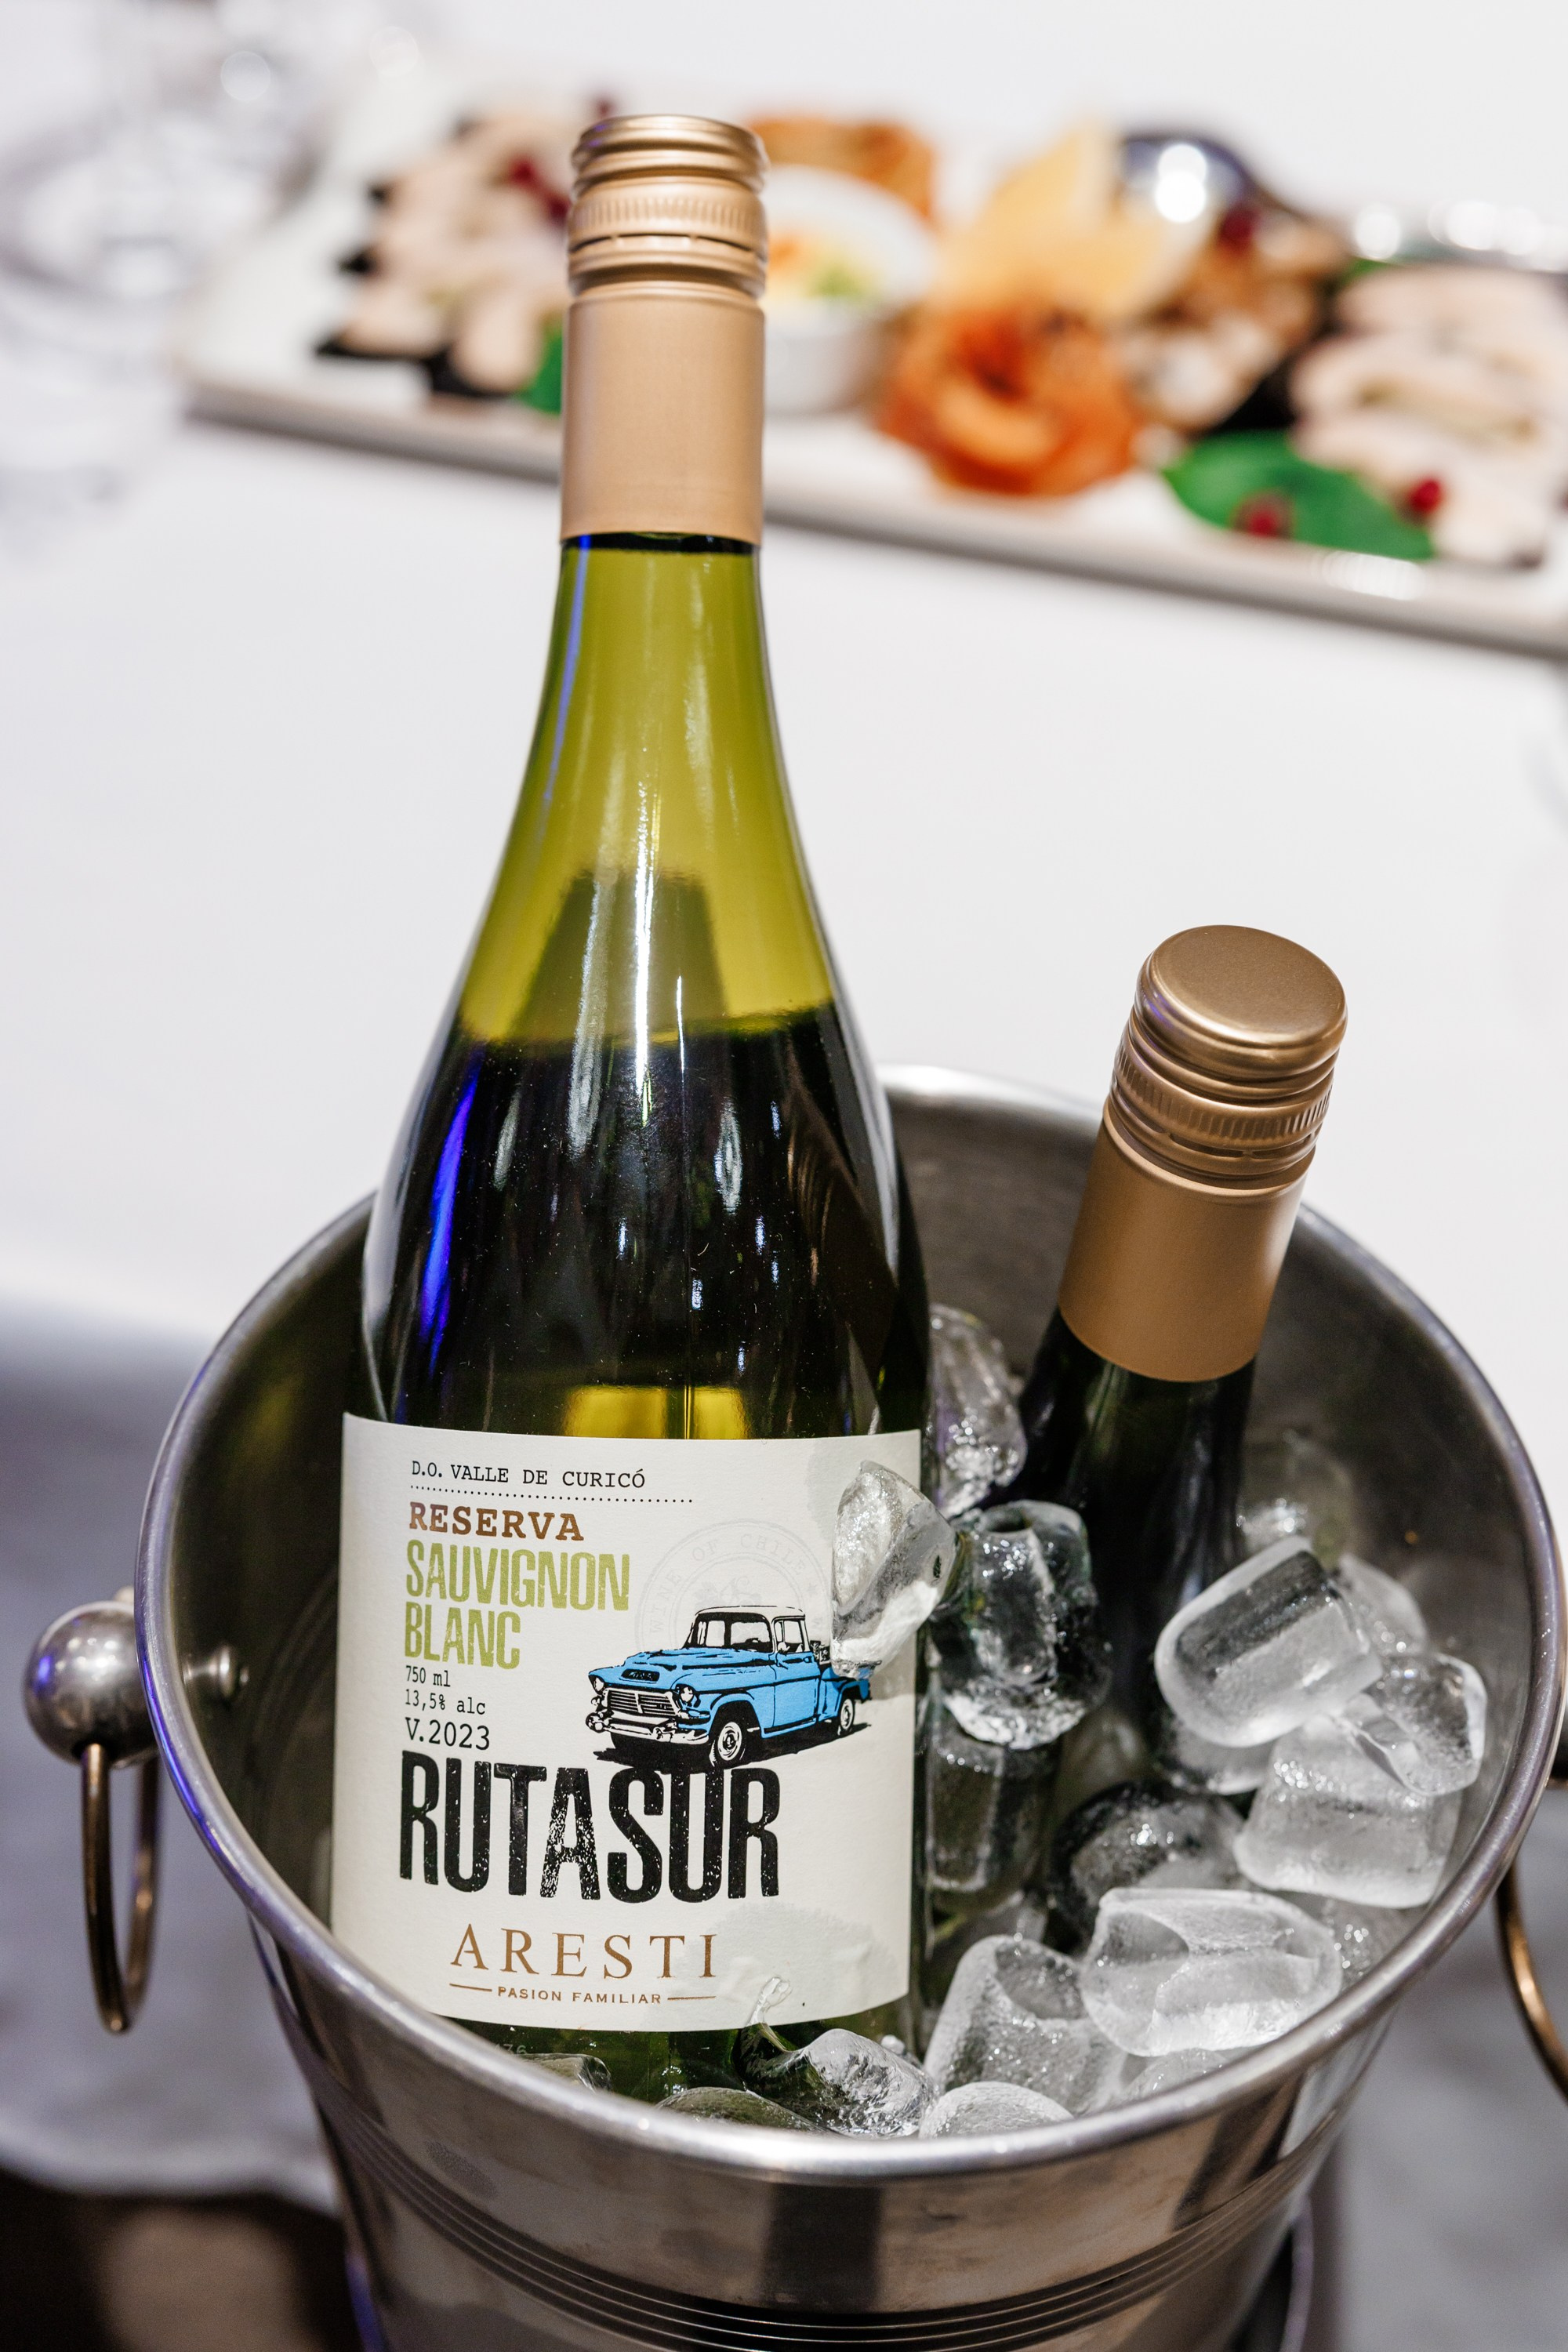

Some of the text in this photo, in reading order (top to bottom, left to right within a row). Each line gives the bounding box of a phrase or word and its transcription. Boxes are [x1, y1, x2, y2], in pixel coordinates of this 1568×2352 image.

[412, 1461, 645, 1489] D.O. VALLE DE CURICÓ
[409, 1501, 585, 1541] RESERVA
[406, 1539, 630, 1611] SAUVIGNON
[405, 1601, 521, 1670] BLANC
[405, 1665, 451, 1687] 750 ml
[405, 1689, 485, 1715] 13,5% alc
[405, 1717, 490, 1751] V.2023
[399, 1750, 781, 1904] RUTASUR
[450, 1924, 717, 1980] ARESTI
[498, 1986, 661, 2005] PASION FAMILIAR
